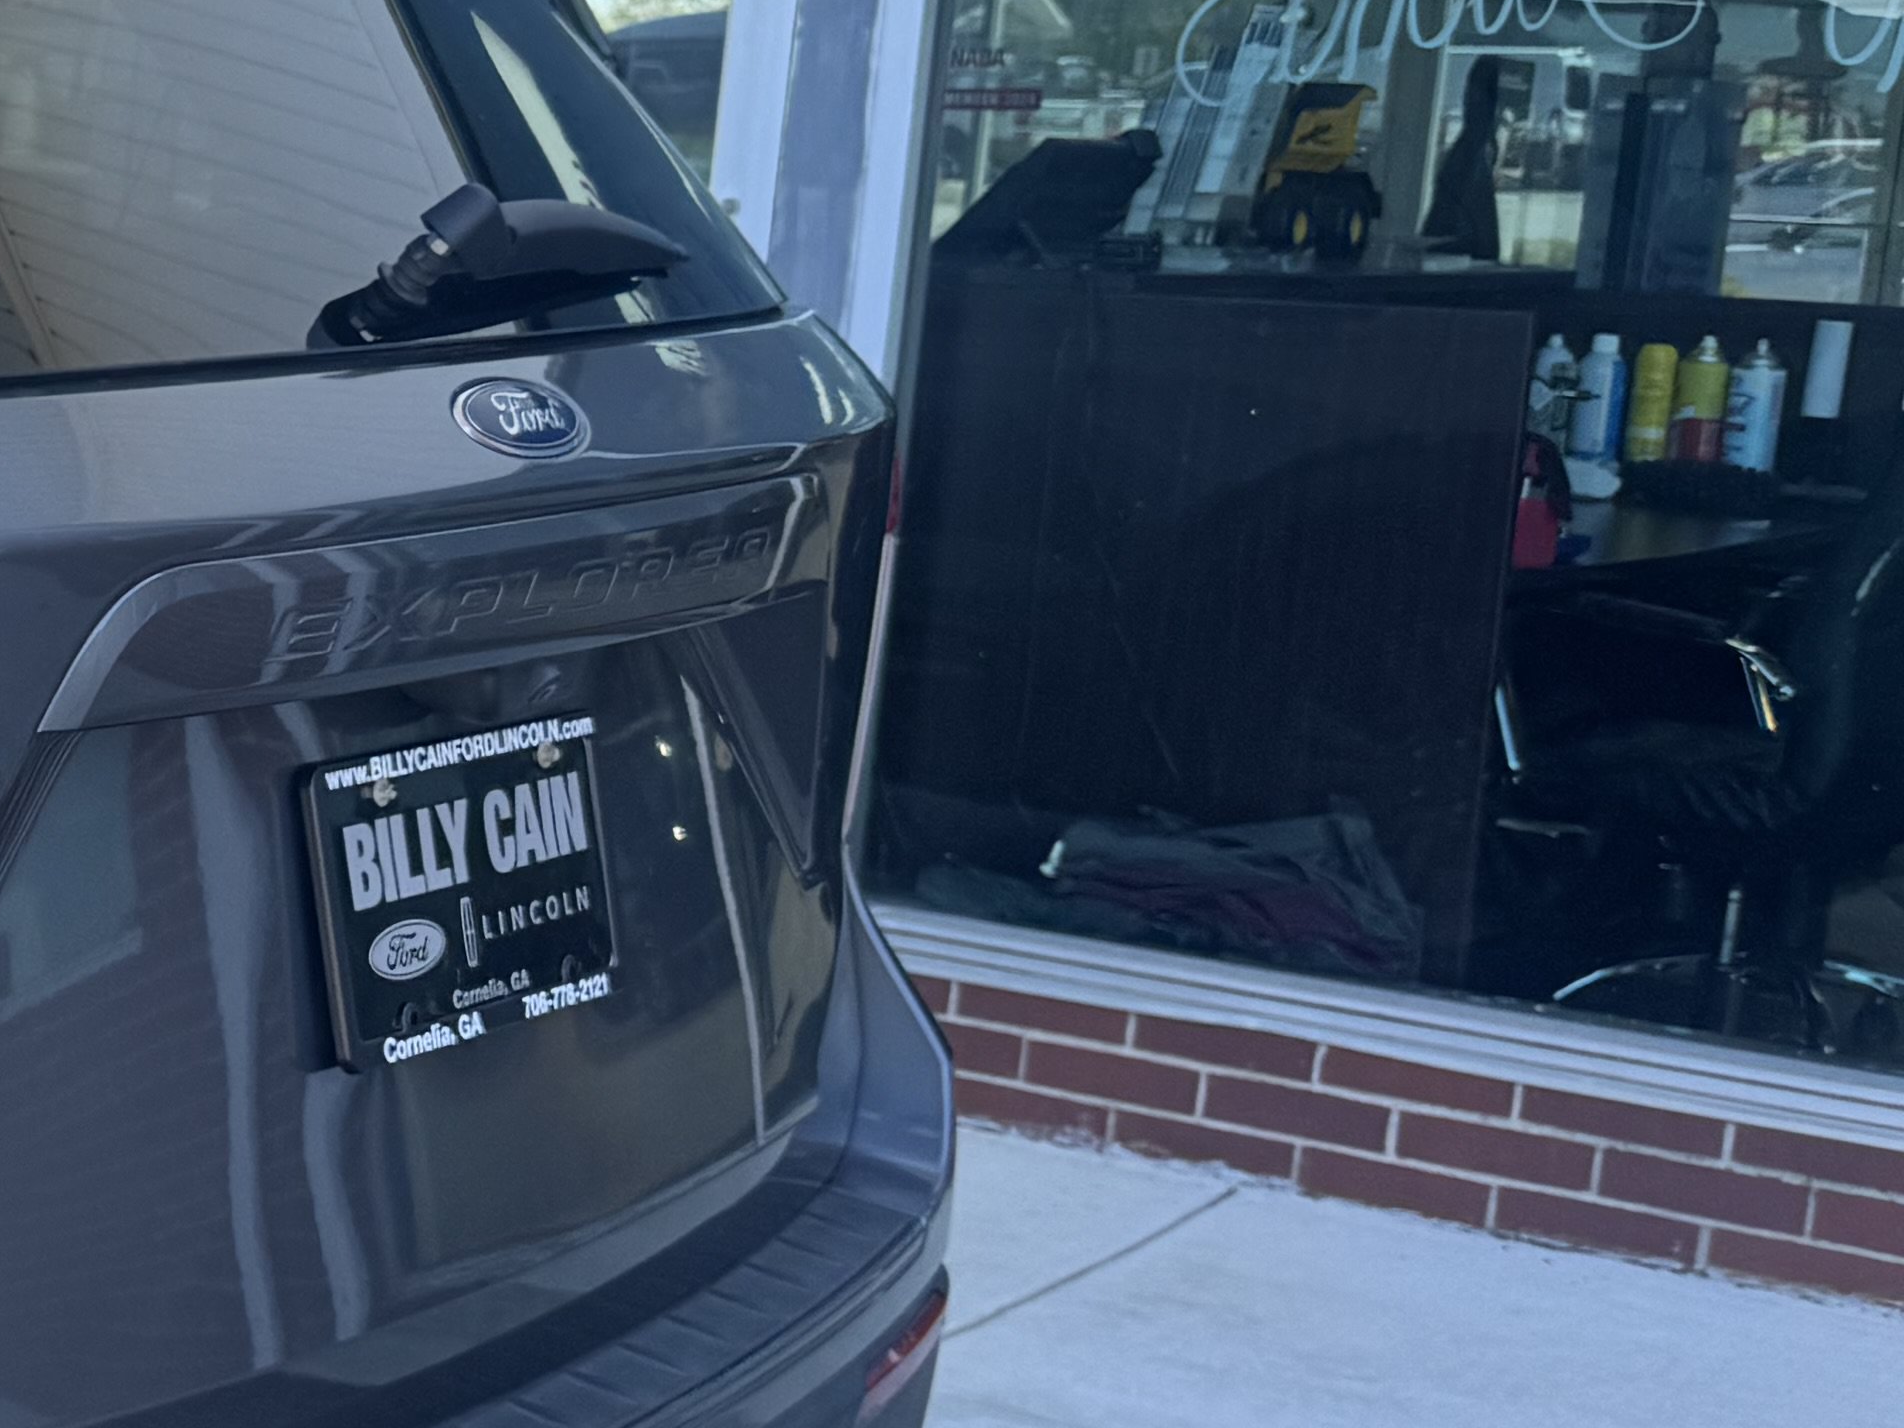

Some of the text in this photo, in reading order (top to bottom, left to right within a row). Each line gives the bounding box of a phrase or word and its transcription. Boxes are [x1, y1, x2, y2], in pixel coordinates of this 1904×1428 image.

[491, 389, 568, 436] Ford
[270, 527, 774, 663] EXPLORER
[324, 717, 594, 791] www.BILLYCAINFORDLINCOLN.com
[342, 771, 588, 912] BILLY CAIN
[482, 885, 591, 940] LINCOLN
[510, 969, 530, 992] GA
[522, 974, 610, 1019] 706-778-2121
[457, 1012, 486, 1040] GA
